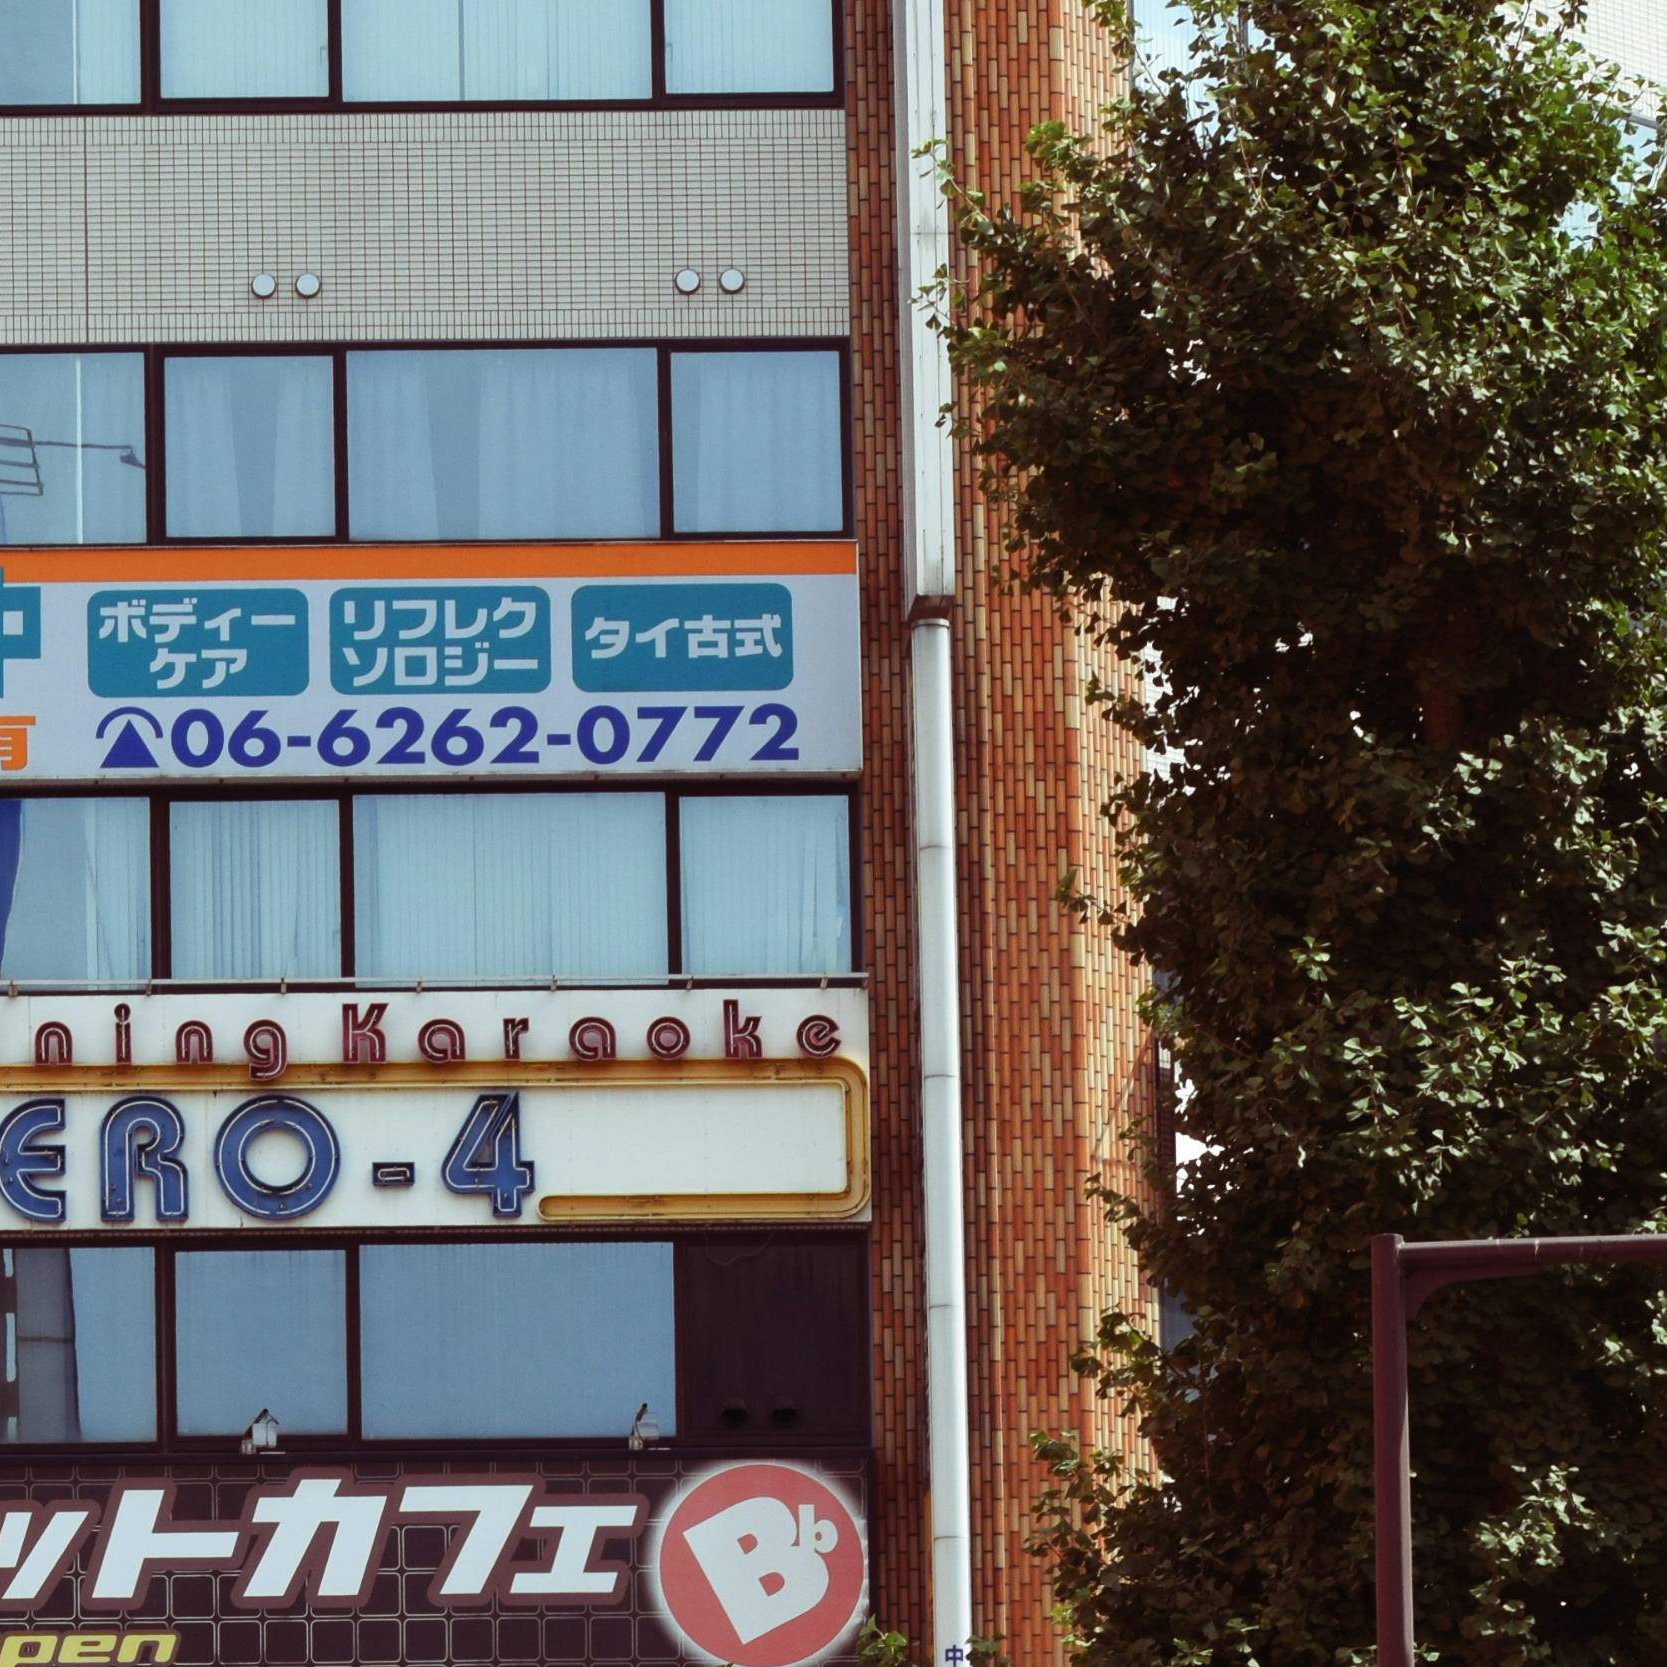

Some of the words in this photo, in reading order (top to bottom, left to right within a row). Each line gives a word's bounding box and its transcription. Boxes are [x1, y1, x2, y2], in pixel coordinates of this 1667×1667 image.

[99, 597, 295, 643] ボディー
[343, 597, 537, 640] リフレク
[585, 614, 783, 659] タイ古式
[150, 648, 248, 690] ケア
[343, 645, 538, 688] ソロジー
[171, 704, 800, 768] 06-6262-0772
[344, 998, 841, 1065] Karaoke
